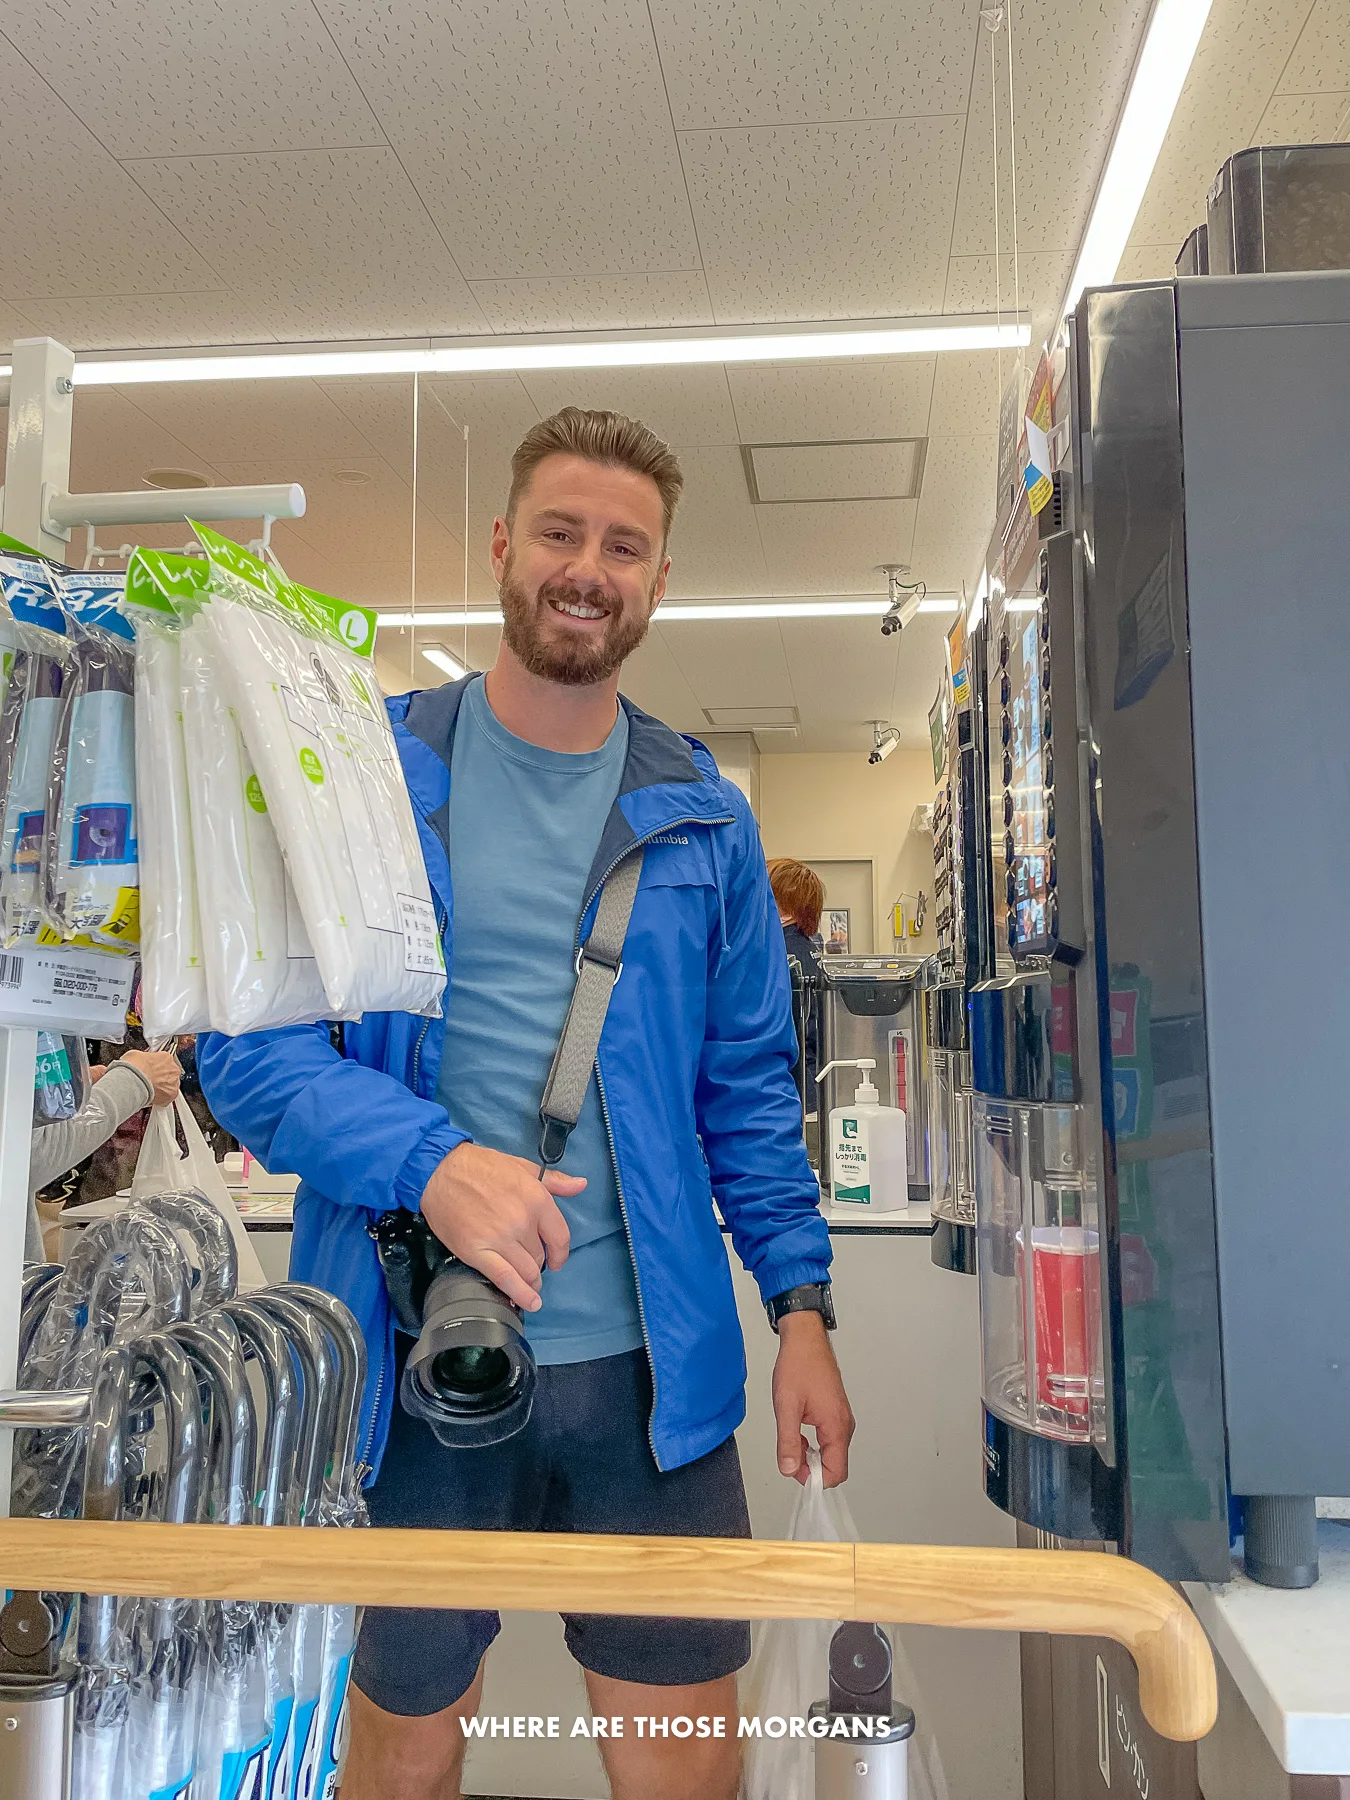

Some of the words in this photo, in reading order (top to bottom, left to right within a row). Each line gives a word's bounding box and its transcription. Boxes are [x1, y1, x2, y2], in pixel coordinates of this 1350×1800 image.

[347, 618, 358, 641] L
[838, 1143, 863, 1153] 指先まで
[835, 1153, 867, 1162] しっかり消毒
